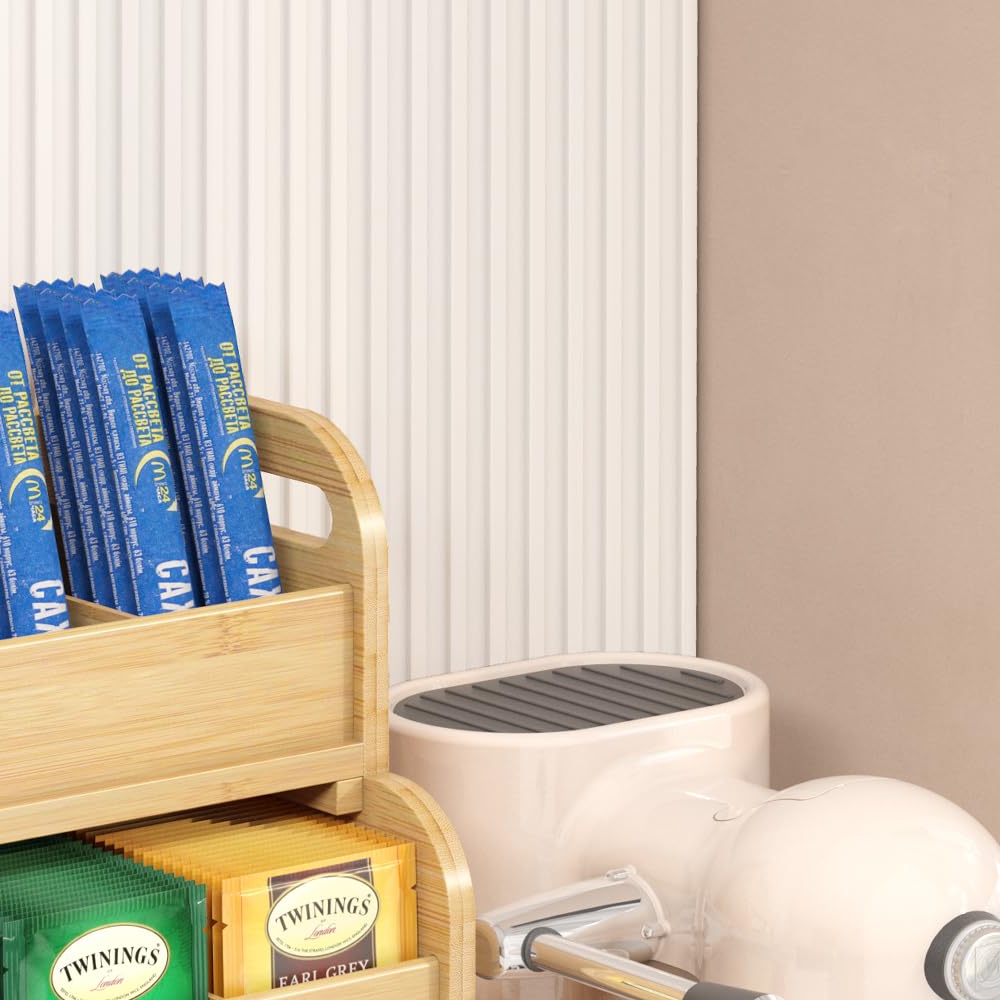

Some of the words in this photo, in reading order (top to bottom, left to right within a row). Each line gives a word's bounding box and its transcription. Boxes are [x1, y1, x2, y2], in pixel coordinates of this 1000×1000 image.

[132, 354, 149, 372] ОТ
[220, 342, 236, 360] ОТ
[120, 369, 139, 386] ДО
[207, 358, 226, 374] ДО
[8, 370, 25, 390] ОТ
[139, 375, 164, 442] РАССВЕТА
[216, 378, 239, 434] РАССВЕТА
[226, 363, 251, 430] РАССВЕТА
[12, 392, 39, 460] РАССВЕТА
[128, 390, 152, 446] РАССВЕТА
[3, 407, 26, 464] РАССВЕТА
[159, 487, 170, 502] 24
[246, 474, 257, 489] 24
[33, 505, 45, 521] 24
[275, 897, 371, 932] TWININGS
[59, 946, 160, 982] TWININGS
